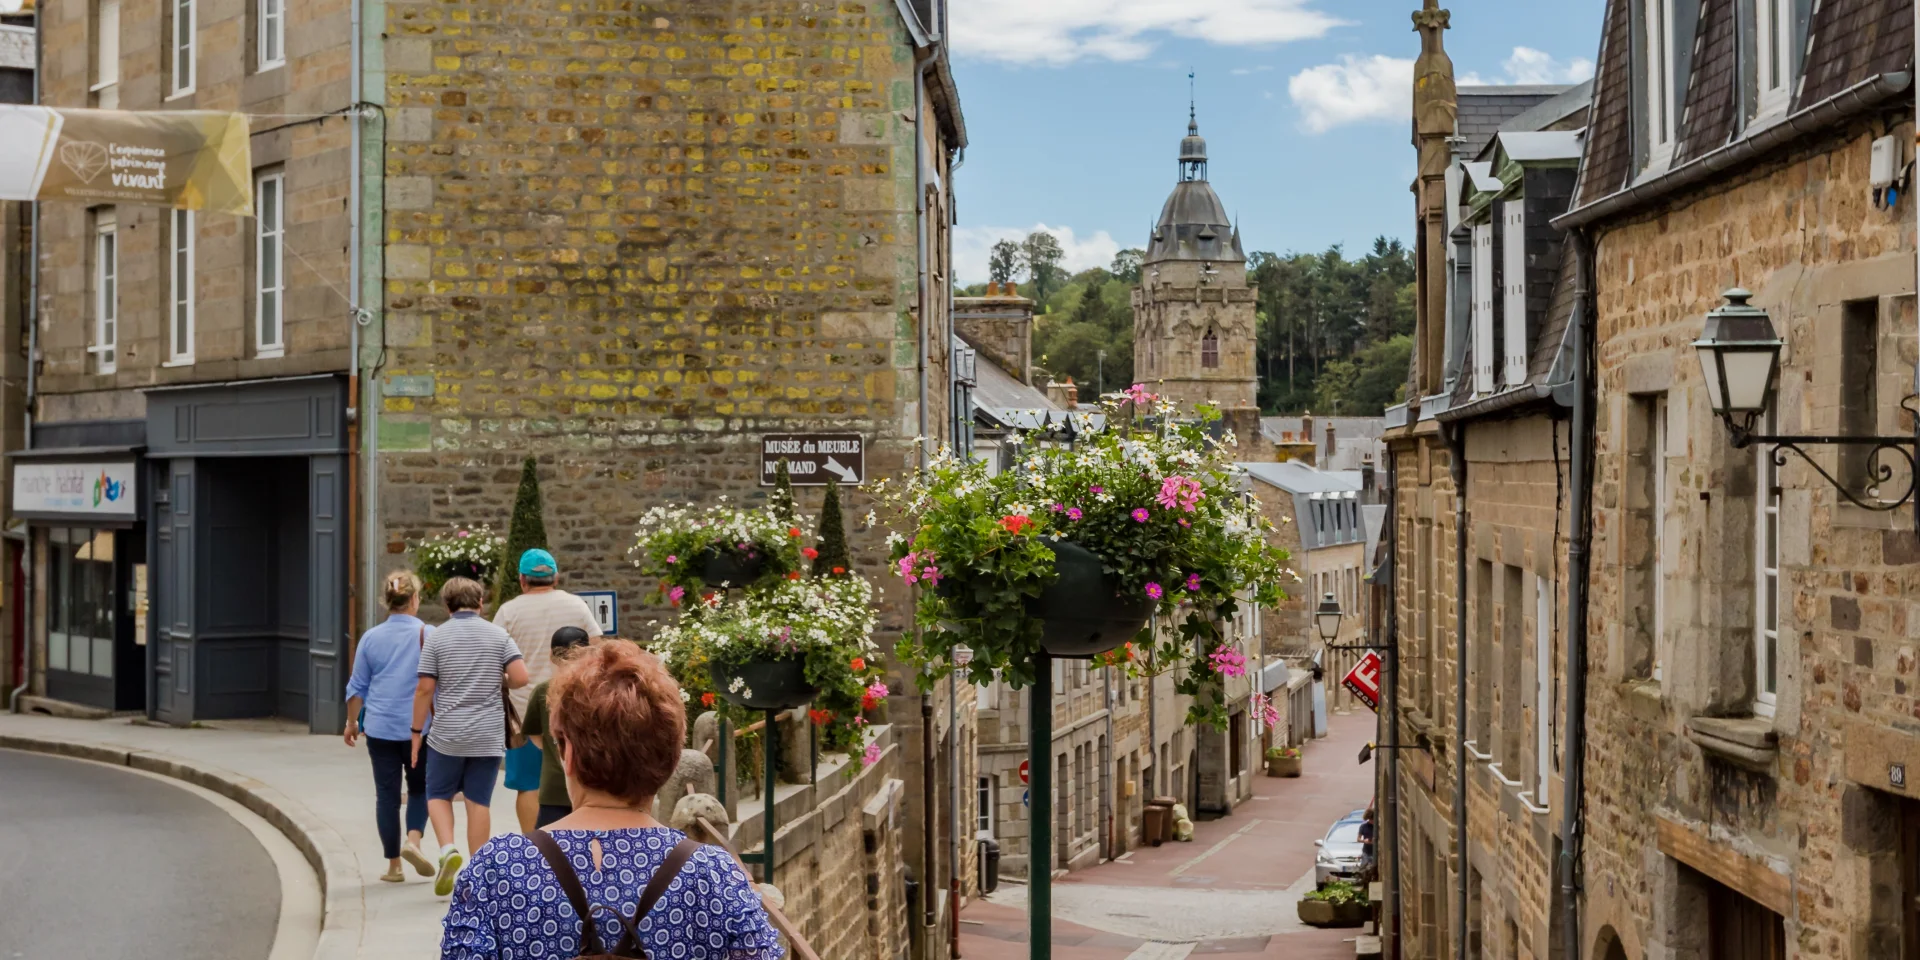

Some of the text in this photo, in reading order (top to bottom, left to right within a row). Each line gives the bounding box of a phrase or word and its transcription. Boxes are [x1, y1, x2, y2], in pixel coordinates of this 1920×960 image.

[110, 156, 166, 171] patrimoine
[111, 169, 167, 189] vivant
[765, 437, 860, 454] MUSÉE du MEUBLE
[765, 461, 816, 474] NOMAND
[1346, 681, 1374, 707] VENDU
